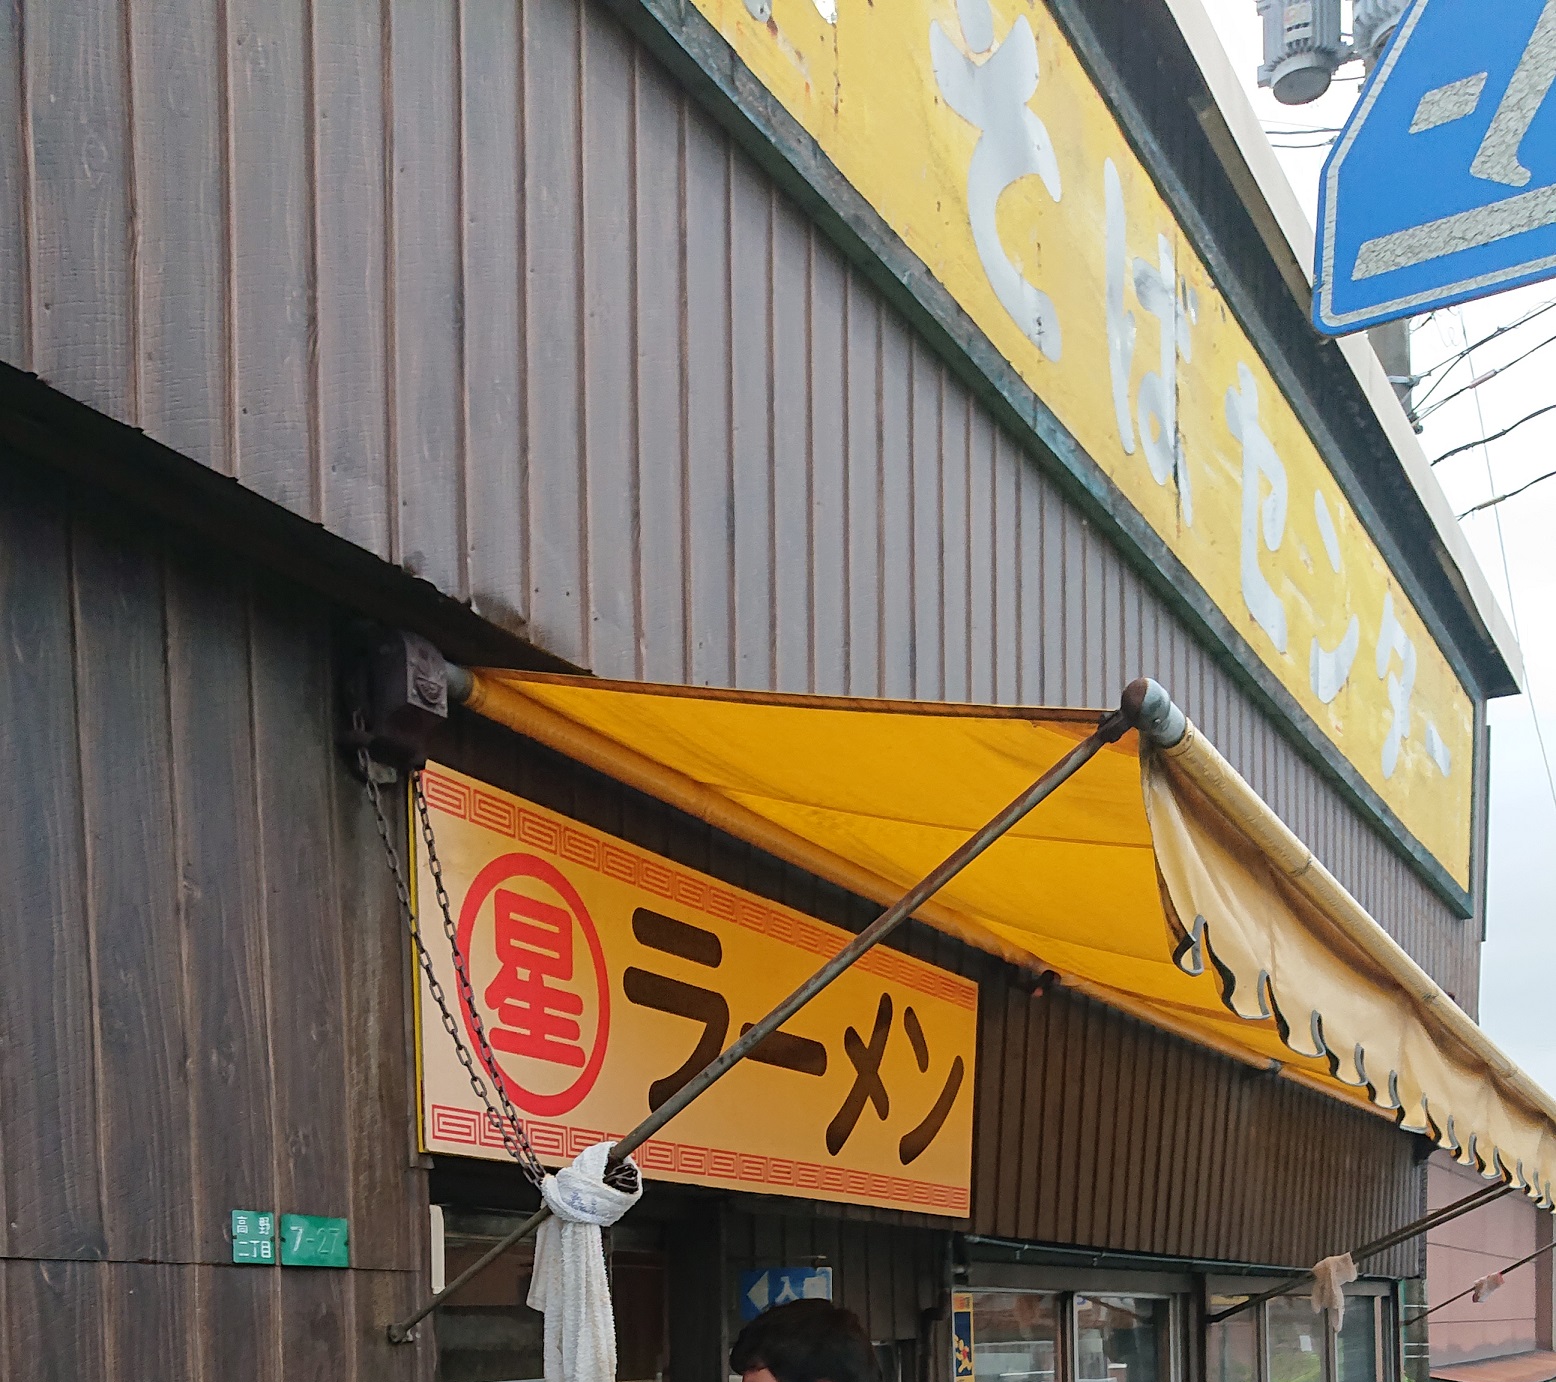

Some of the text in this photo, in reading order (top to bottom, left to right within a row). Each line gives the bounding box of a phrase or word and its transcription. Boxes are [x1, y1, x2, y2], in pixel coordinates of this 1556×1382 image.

[743, 0, 1450, 780] そばセンター
[238, 1240, 272, 1259] 二丁目
[290, 1226, 340, 1254] 7-27
